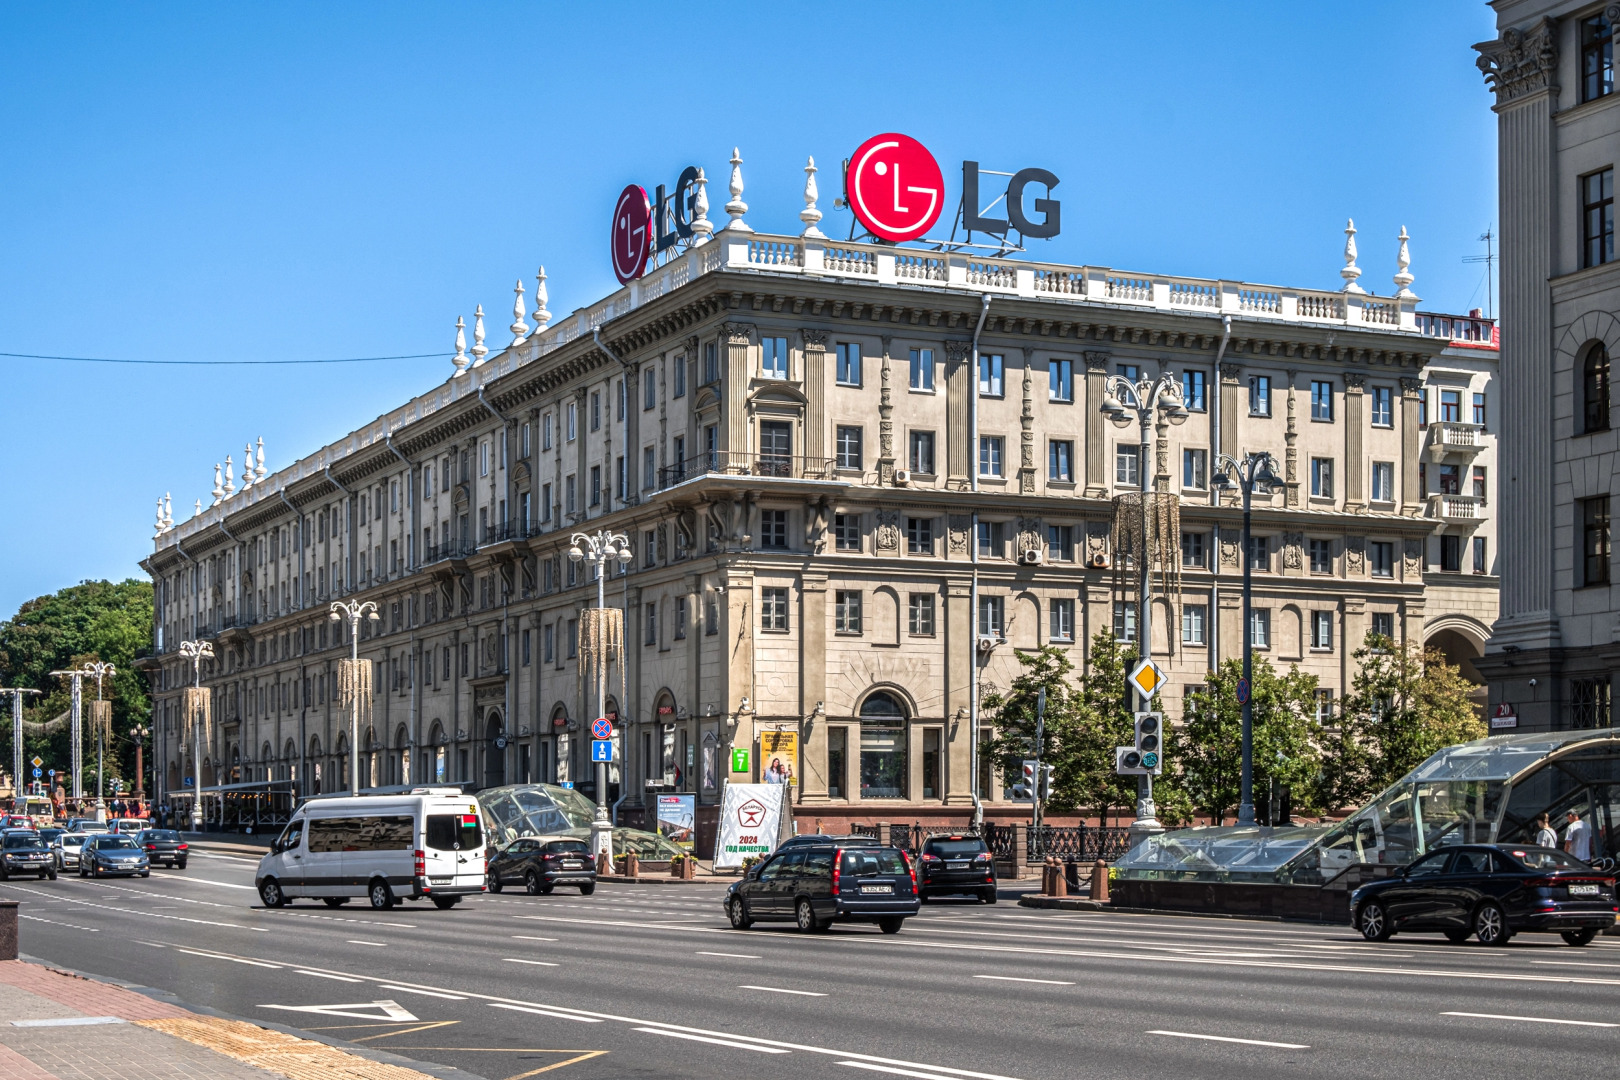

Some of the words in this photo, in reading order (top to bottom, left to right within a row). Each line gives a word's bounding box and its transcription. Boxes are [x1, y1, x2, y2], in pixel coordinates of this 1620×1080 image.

[962, 160, 1061, 239] LG
[655, 166, 699, 253] LG
[1500, 704, 1510, 716] 20
[737, 758, 744, 770] 7
[469, 804, 477, 814] 56
[739, 835, 758, 844] 2024
[725, 845, 738, 853] ГОД
[738, 845, 769, 853] КАЧЕСТВА
